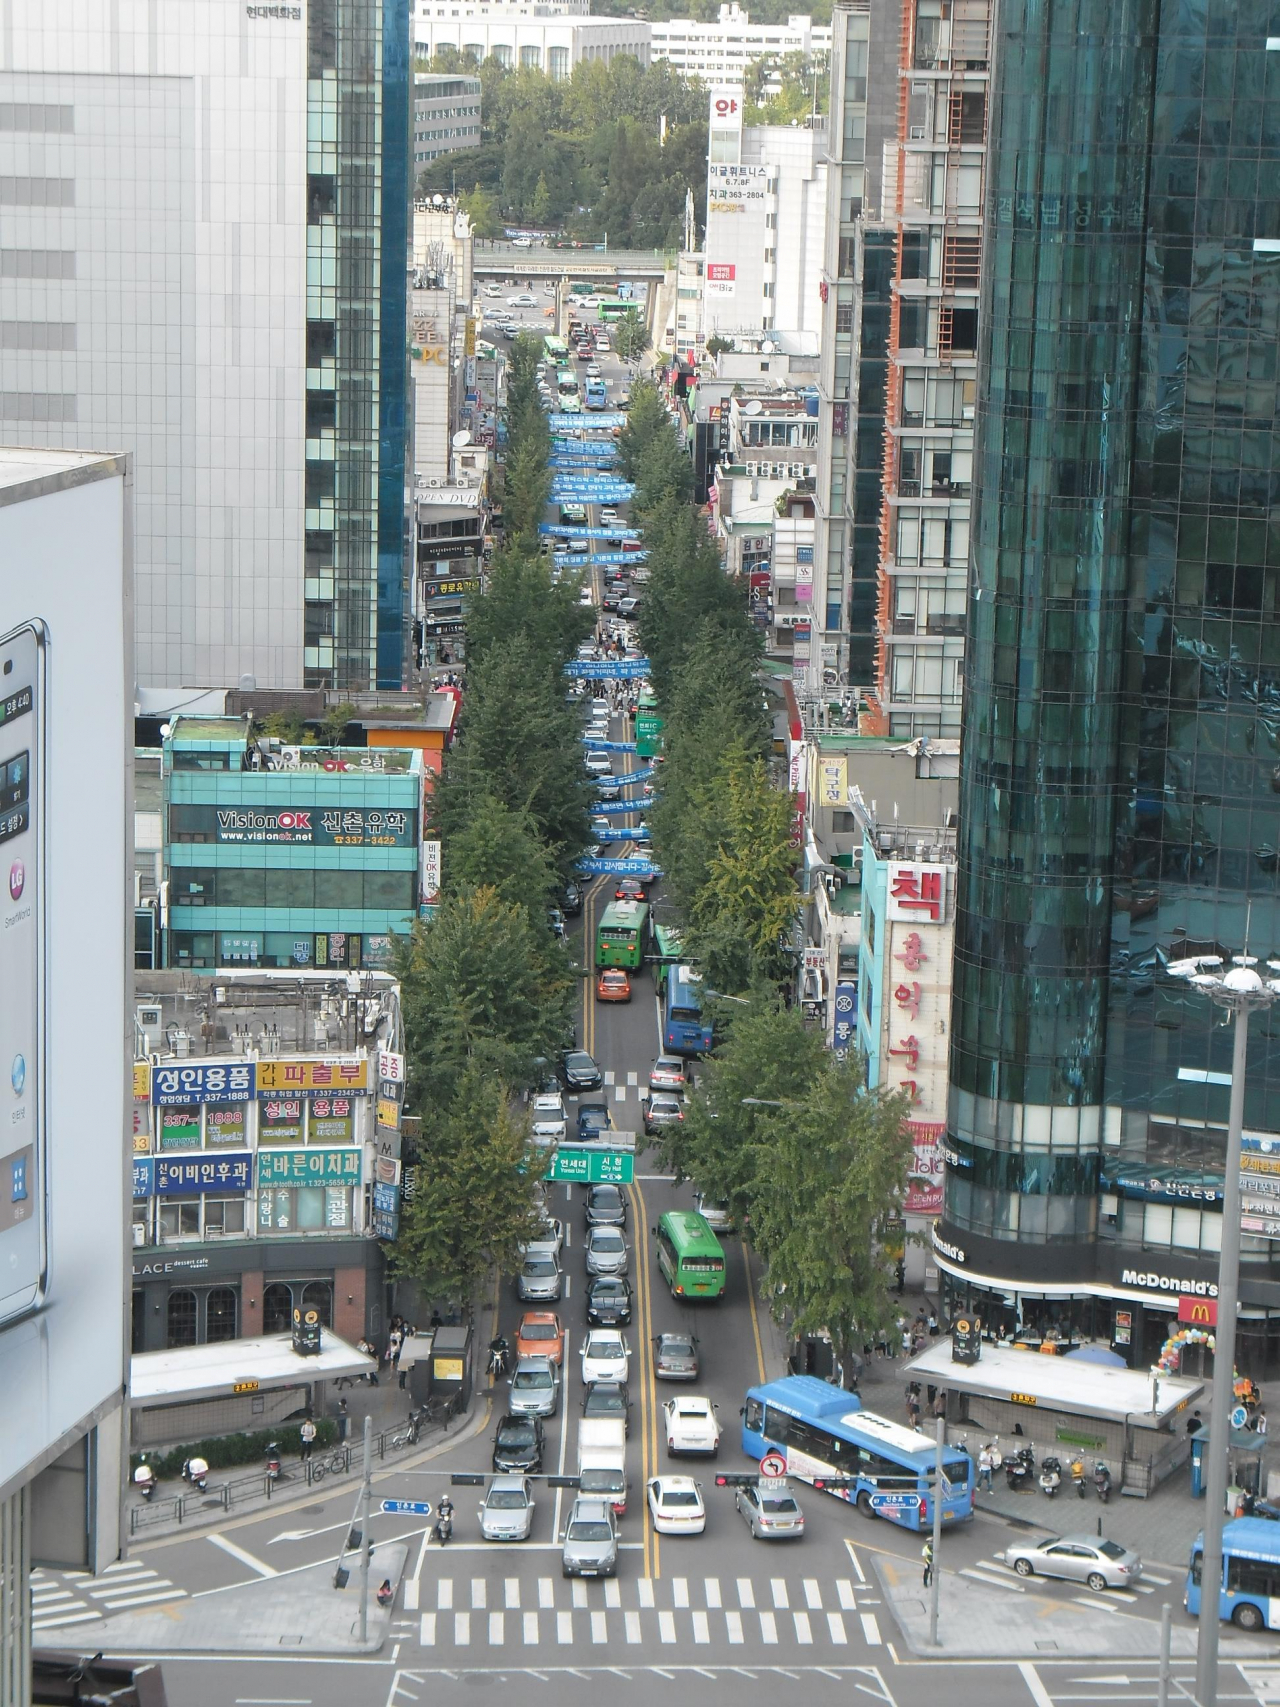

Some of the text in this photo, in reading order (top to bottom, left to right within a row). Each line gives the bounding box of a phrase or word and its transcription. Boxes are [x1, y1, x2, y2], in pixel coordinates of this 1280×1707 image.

[246, 6, 301, 20] 현대백화점
[709, 189, 764, 199] 치과 363-2804
[421, 346, 447, 366] PC
[417, 493, 477, 503] OPEN DVD
[323, 760, 348, 773] OK
[791, 755, 800, 786] Mr.Pizza
[825, 767, 841, 800] 탁구장
[217, 810, 406, 835] VisionOK 신촌유학
[221, 831, 396, 845] www.visionok.net 337-3422
[11, 872, 23, 888] LG
[890, 870, 941, 920] 책
[4, 905, 31, 929] SmartWorld
[330, 934, 345, 962] 공인
[805, 957, 825, 968] 부동산
[156, 1067, 250, 1093] 성인용품
[262, 1063, 360, 1087] 가나 파출부
[195, 1091, 250, 1103] T.337-1888
[314, 1089, 365, 1097] T.337-2342-3
[383, 1083, 397, 1099] 내과
[264, 1099, 350, 1118] 성인 용품
[207, 1112, 243, 1125] 1888
[261, 1153, 360, 1178] 연세 바른이치과
[560, 1156, 622, 1168] 연세대 시청
[158, 1162, 249, 1188] 신촌 이비인후과
[347, 1178, 358, 1186] 2F
[260, 1190, 273, 1228] 사랑니
[277, 1190, 290, 1228] 수술
[174, 1259, 195, 1267] dessert
[1122, 1269, 1219, 1297] McDonald's
